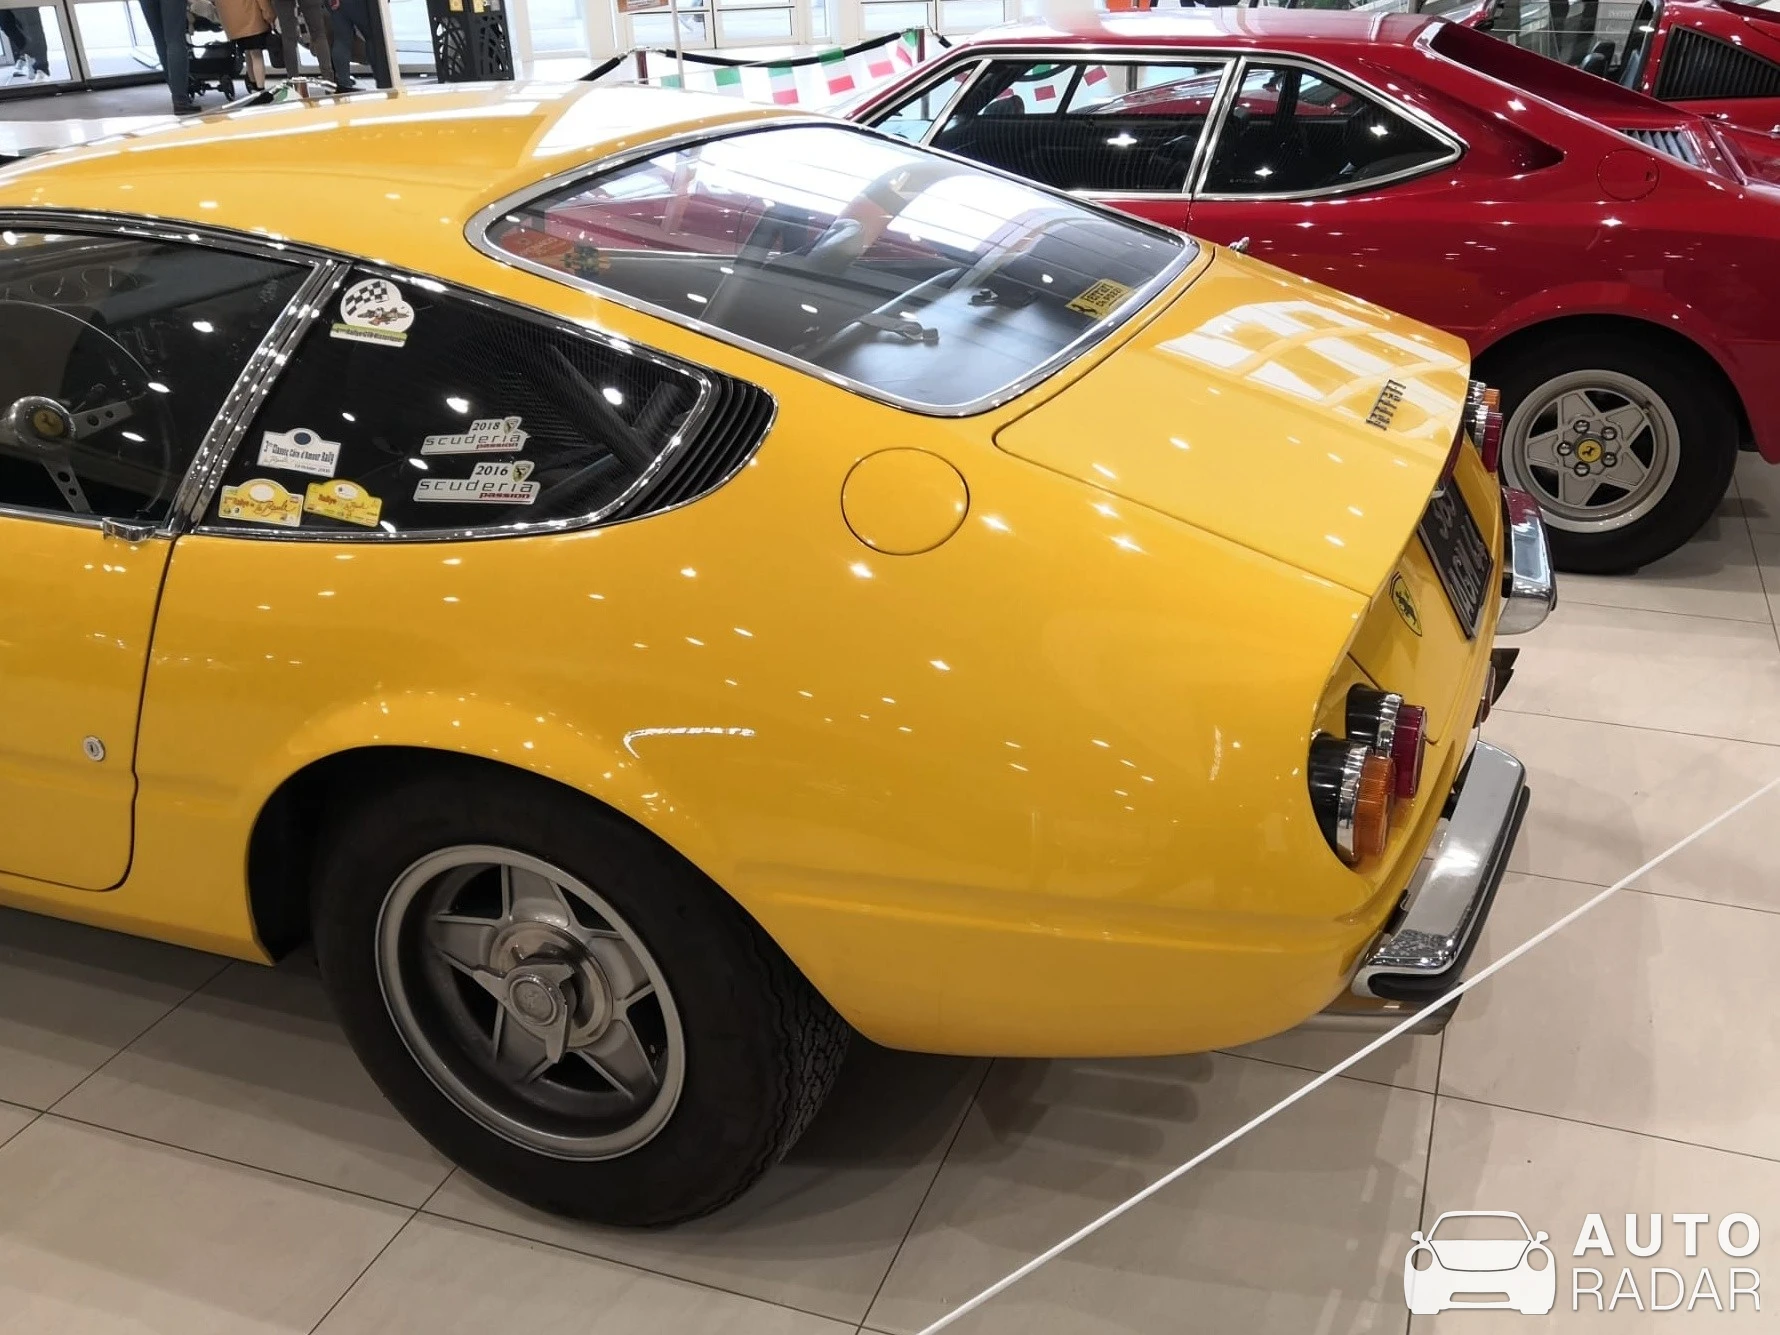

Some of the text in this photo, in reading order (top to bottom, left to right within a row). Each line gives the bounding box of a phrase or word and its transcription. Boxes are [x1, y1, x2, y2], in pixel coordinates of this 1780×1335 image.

[472, 422, 501, 431] 2018
[424, 434, 521, 446] scuderia
[475, 465, 508, 476] 2016
[419, 479, 534, 493] scuderia
